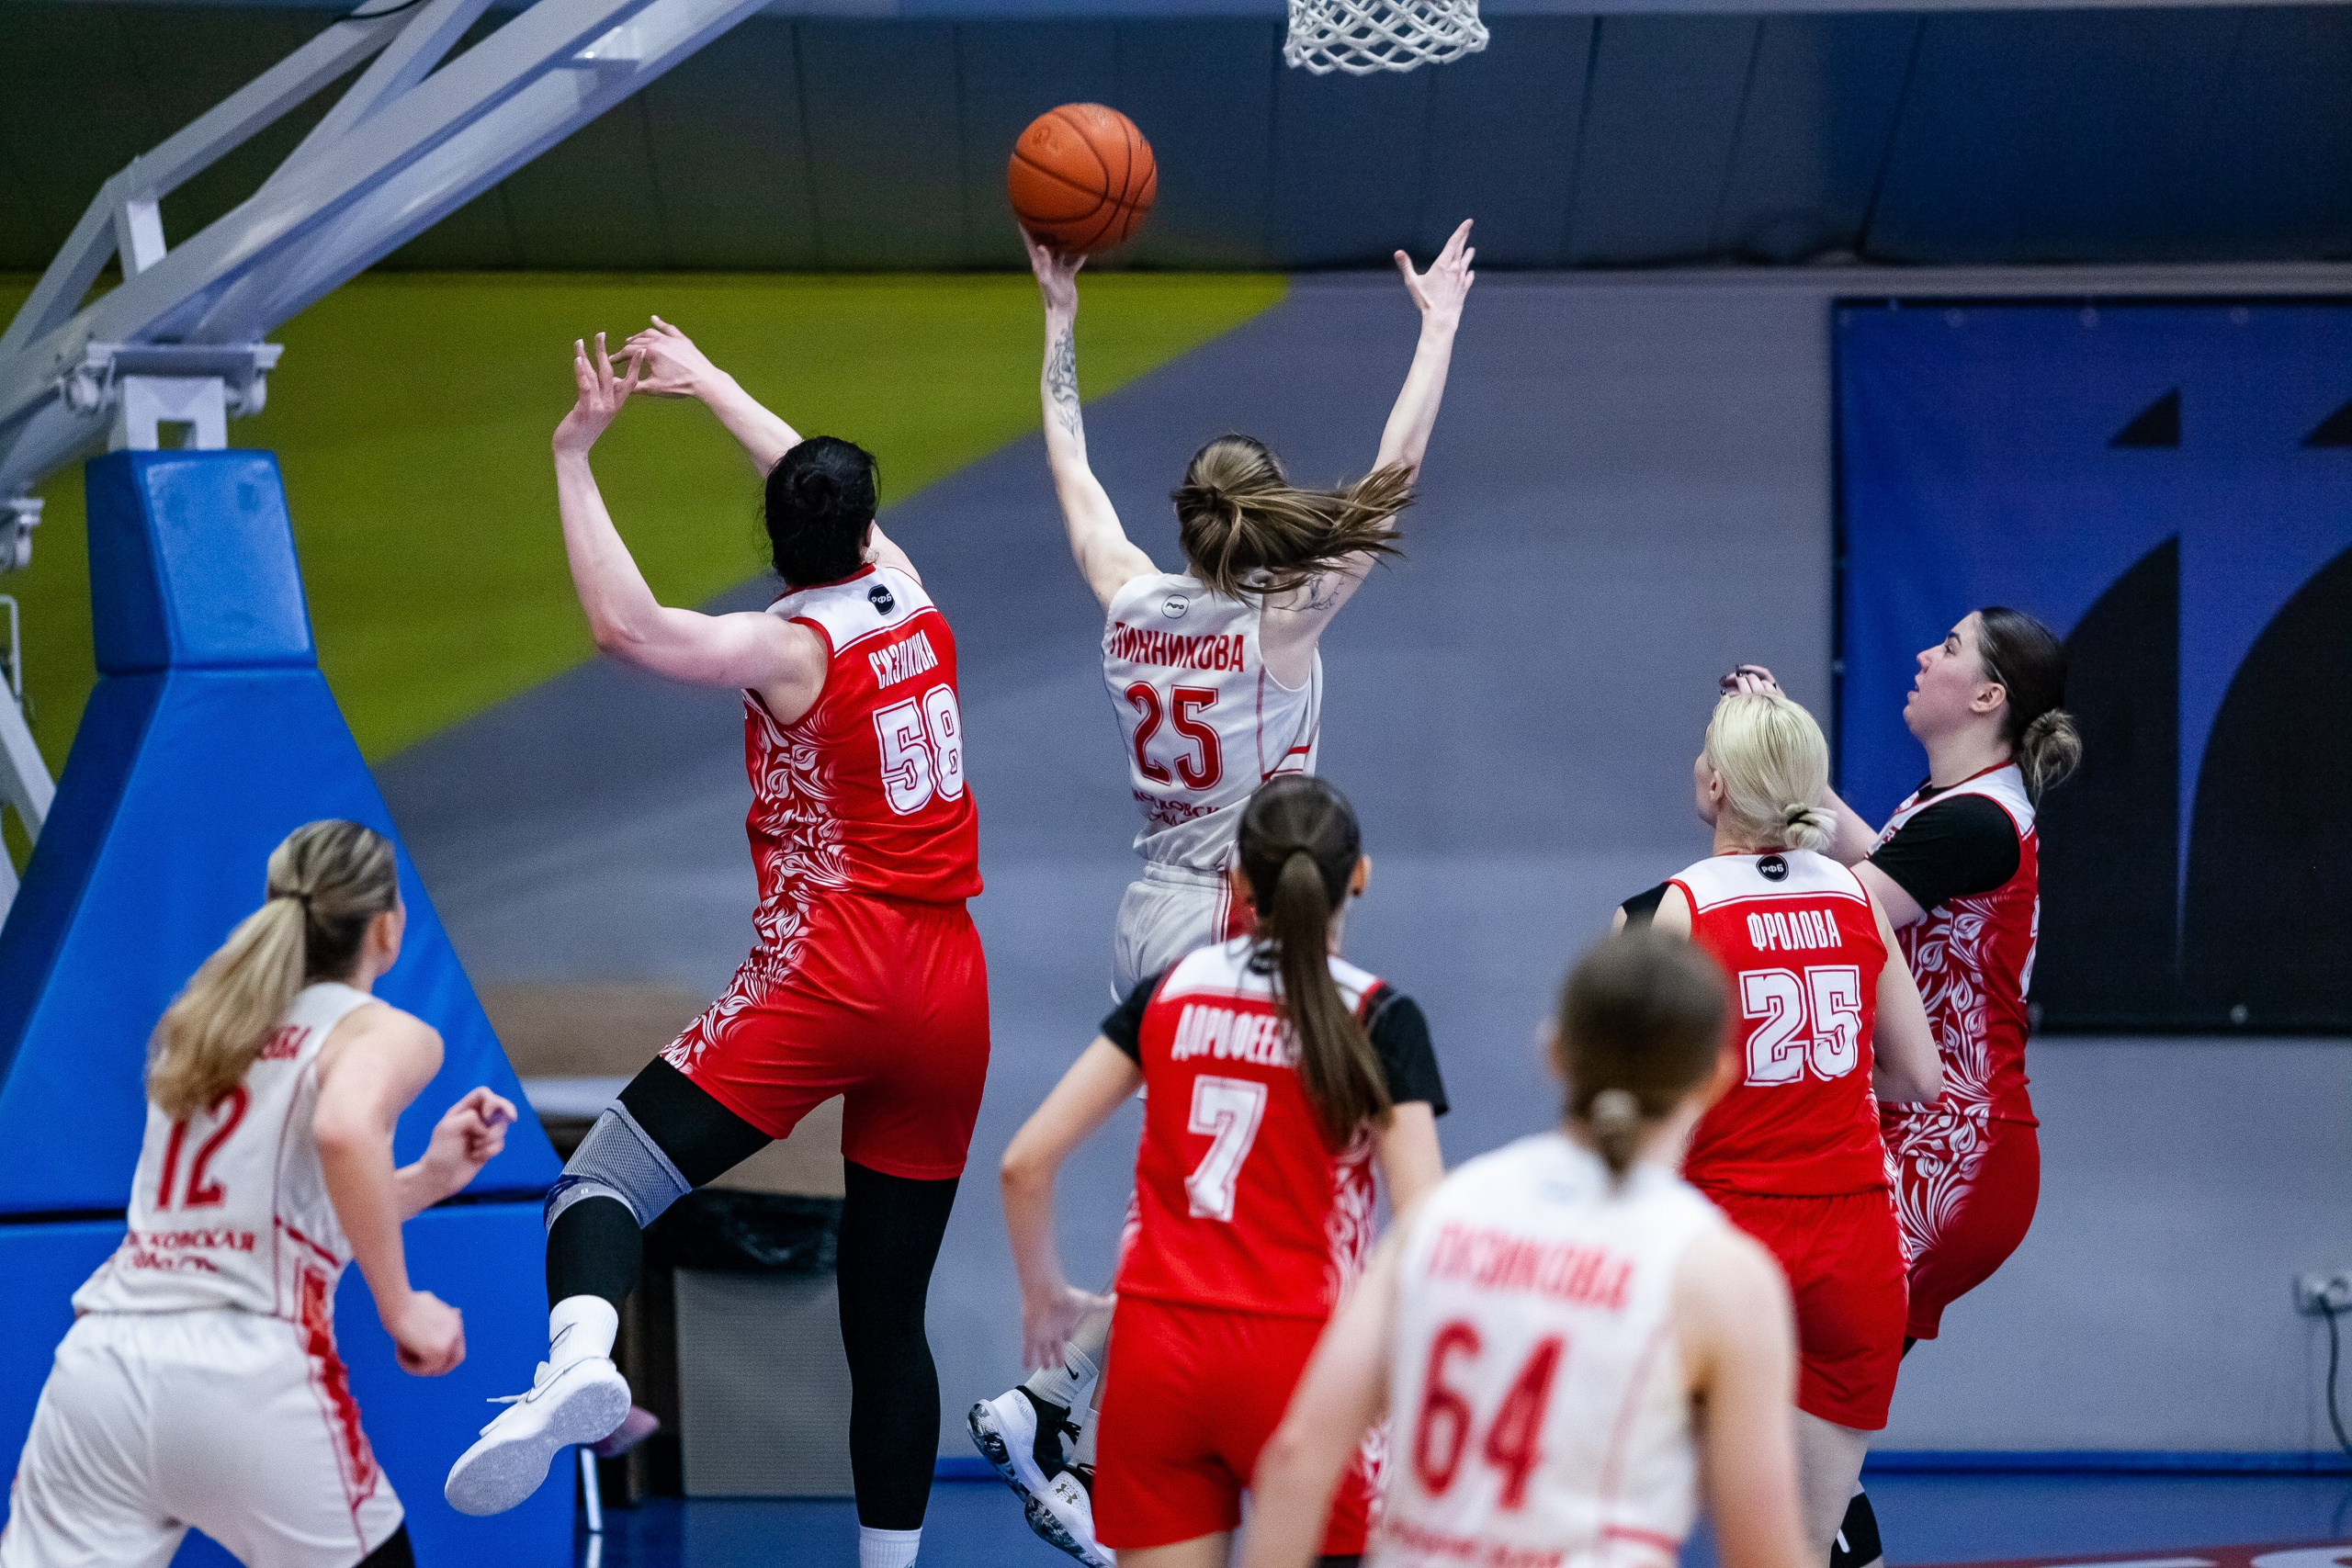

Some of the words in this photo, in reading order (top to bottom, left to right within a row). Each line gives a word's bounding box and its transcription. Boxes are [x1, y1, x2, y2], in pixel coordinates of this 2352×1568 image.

[870, 593, 892, 604] РФБ
[873, 682, 964, 816] 58
[1125, 681, 1223, 791] 25
[1747, 908, 1842, 952] ФРОЛОВА
[1761, 863, 1784, 874] РФБ
[1738, 964, 1861, 1088] 25
[155, 1082, 250, 1213] 12
[1184, 1074, 1268, 1223] 7
[1412, 1318, 1567, 1513] 64
